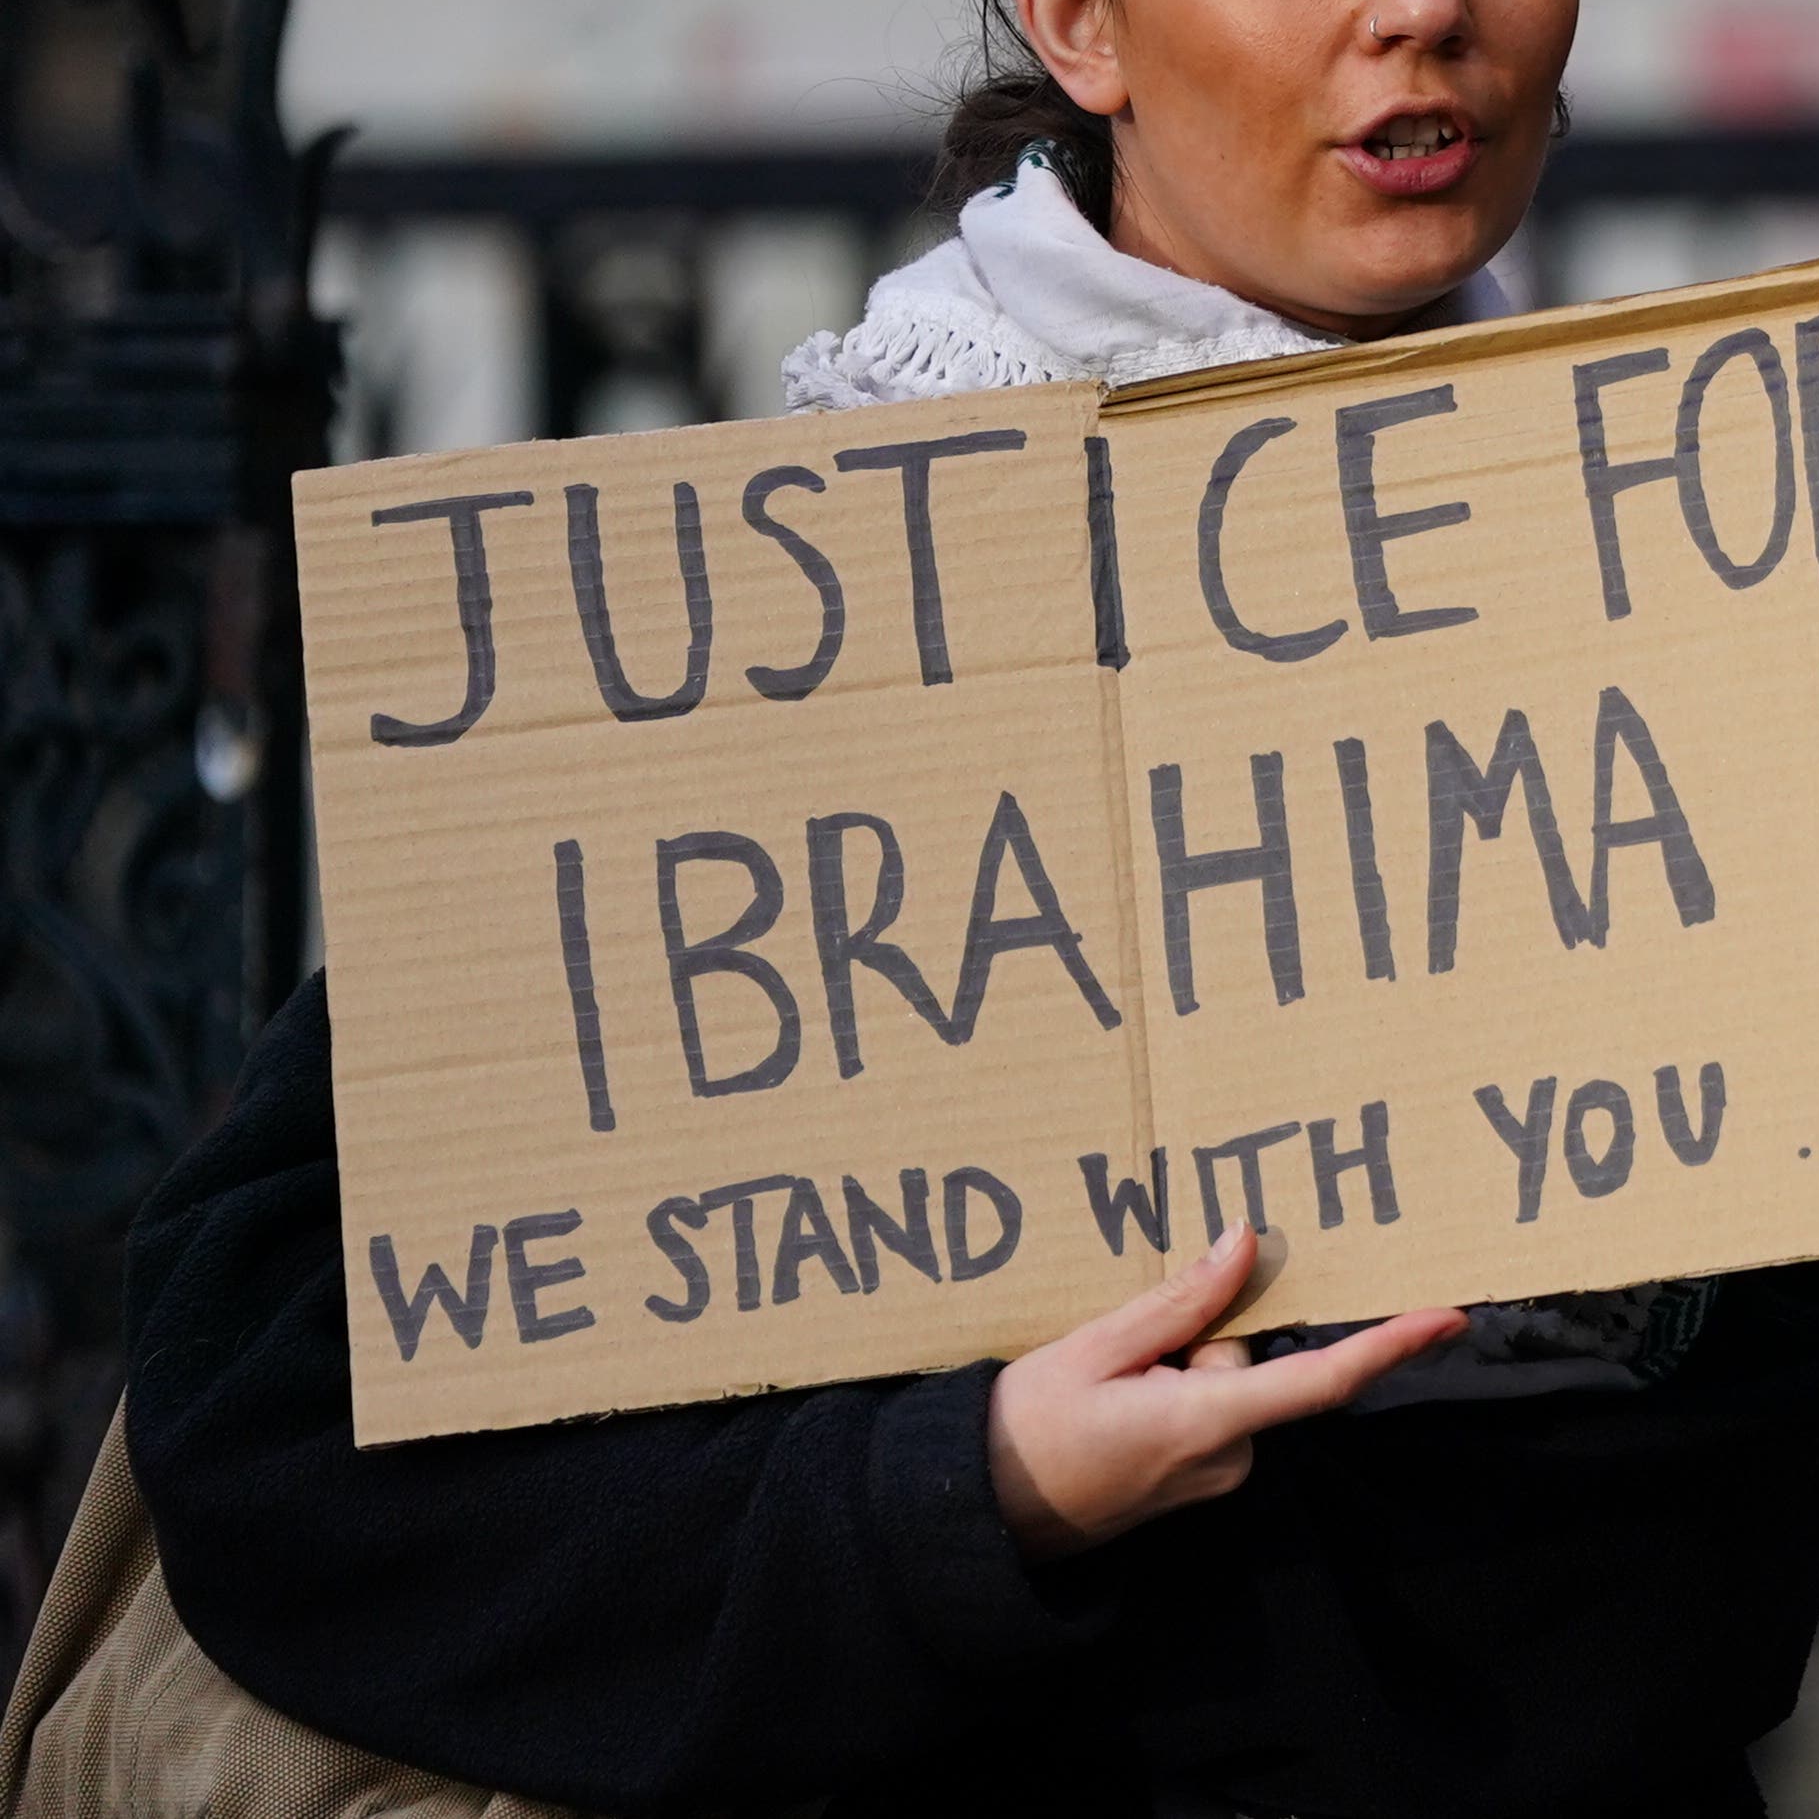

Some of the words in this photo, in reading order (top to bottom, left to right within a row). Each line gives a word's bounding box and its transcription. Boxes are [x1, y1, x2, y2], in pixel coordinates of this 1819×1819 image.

[368, 381, 1481, 748] JUSTICE
[552, 685, 1717, 1133] IBRAHIMA
[368, 1206, 597, 1363] WE
[643, 1164, 1024, 1323] STAND
[1076, 1099, 1401, 1257] WITH
